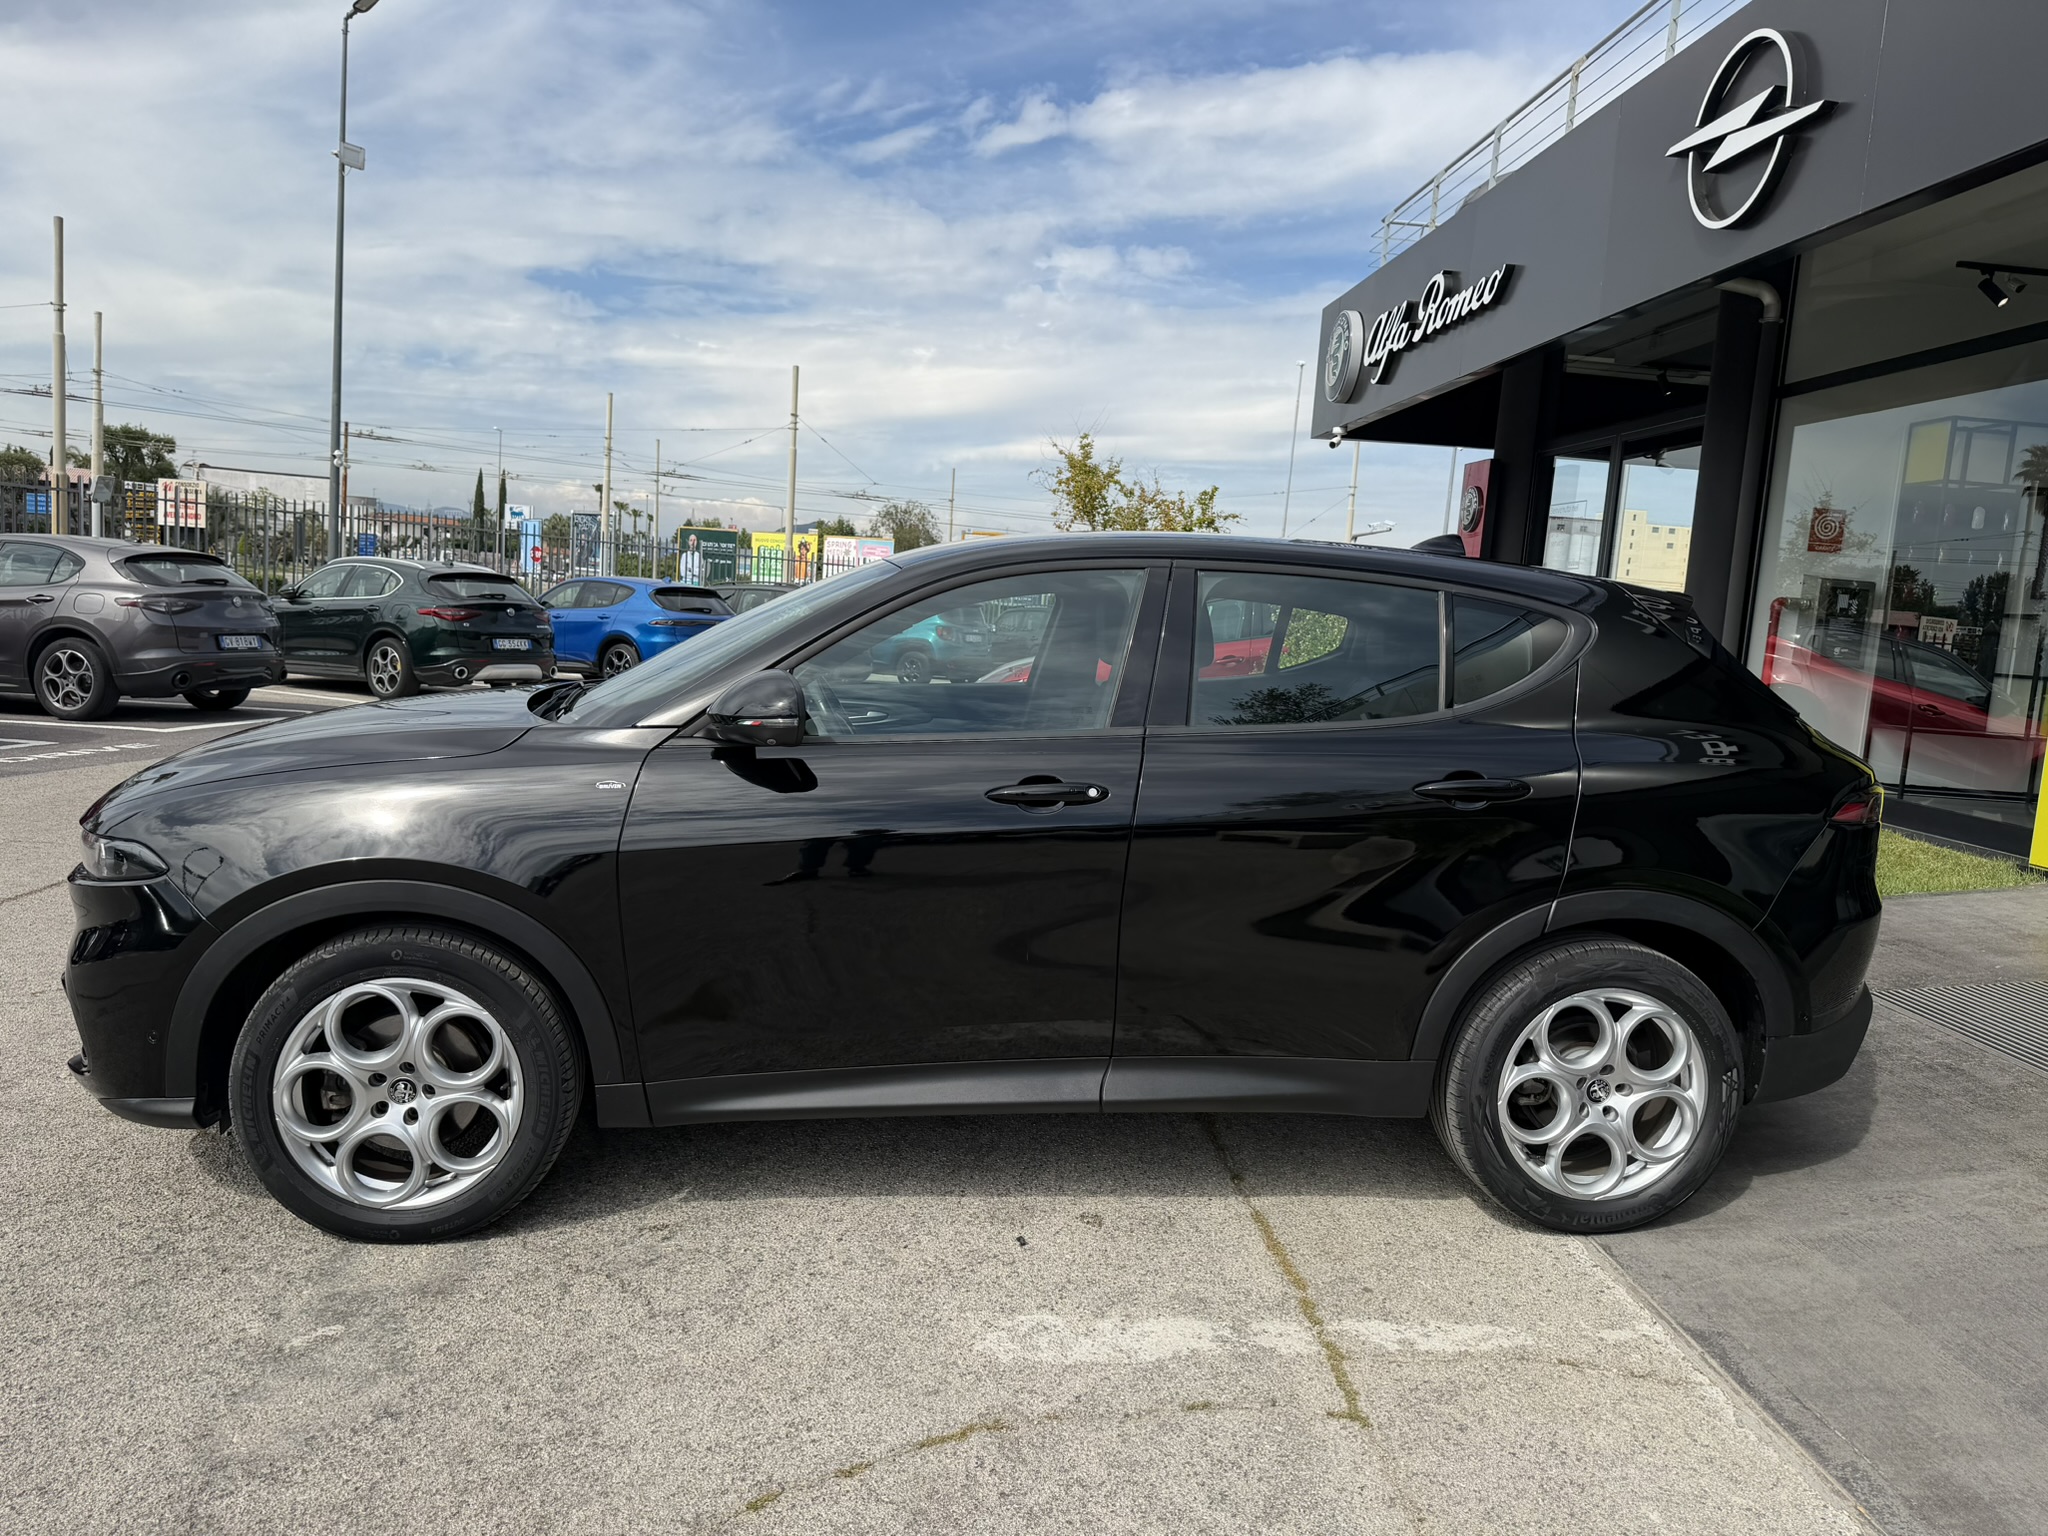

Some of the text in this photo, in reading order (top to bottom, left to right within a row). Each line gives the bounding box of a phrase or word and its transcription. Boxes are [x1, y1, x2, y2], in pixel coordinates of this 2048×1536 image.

[1364, 264, 1506, 384] Alfa Romeo
[827, 540, 852, 549] SPRING
[255, 1002, 286, 1045] PRIMACY
[242, 1054, 259, 1142] MICHELIN
[534, 1051, 550, 1135] MICHELIN
